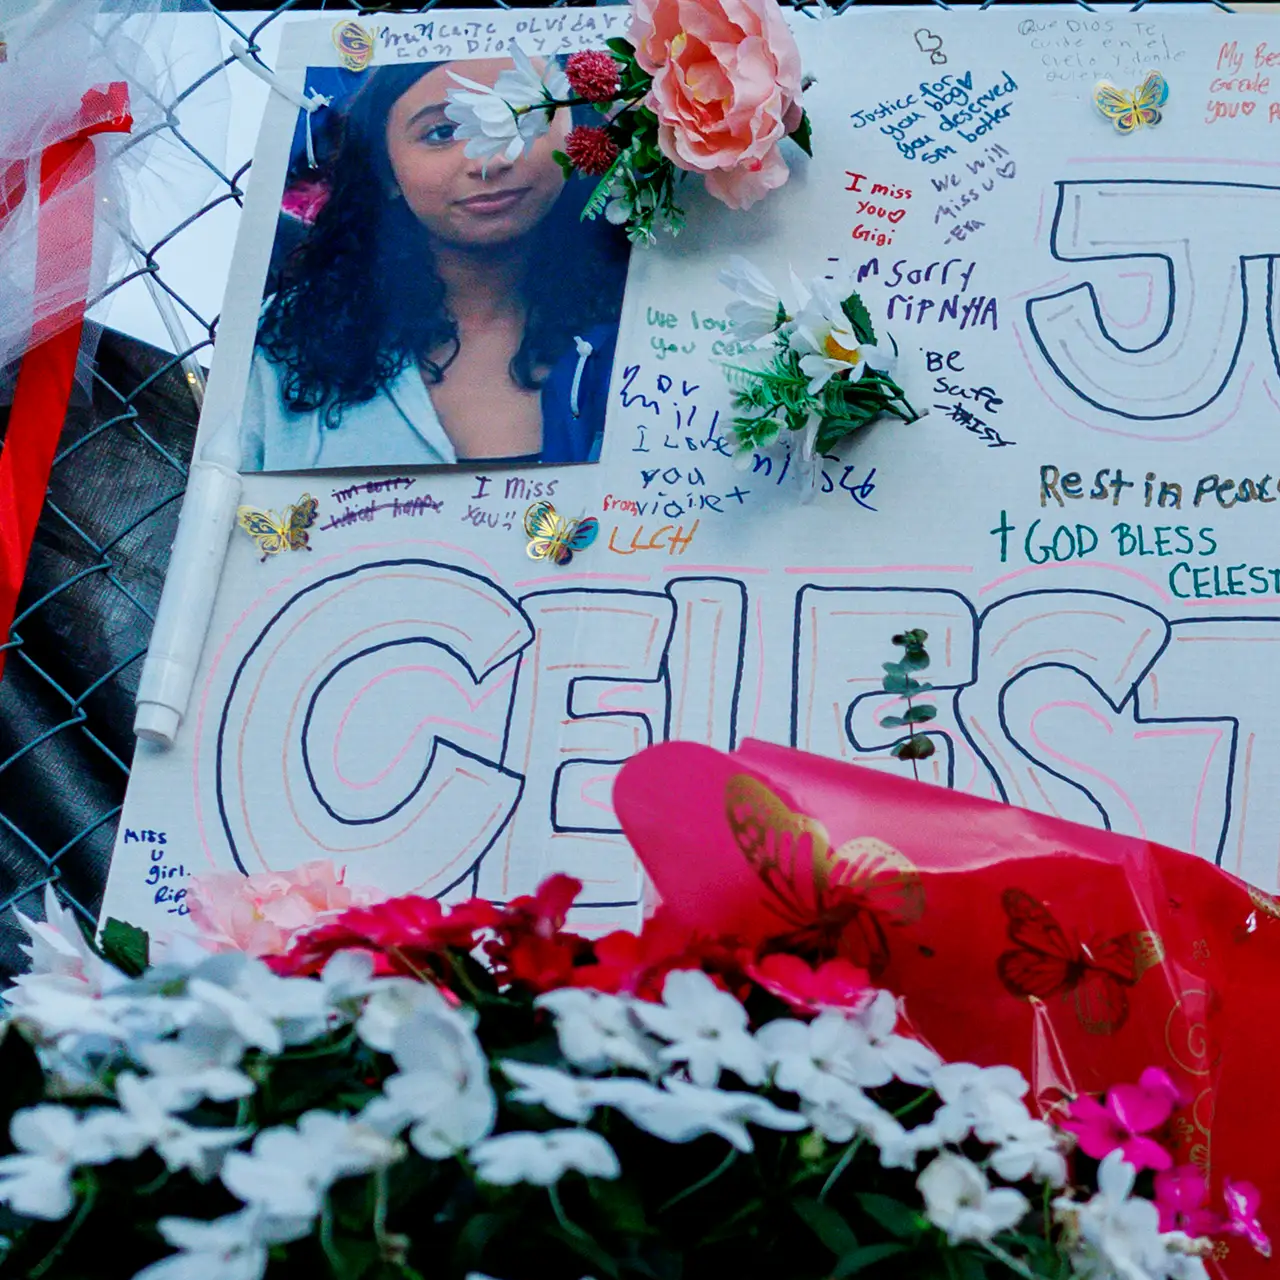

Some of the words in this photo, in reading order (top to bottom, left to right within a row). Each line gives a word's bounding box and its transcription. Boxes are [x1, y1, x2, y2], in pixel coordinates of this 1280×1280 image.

[1216, 41, 1243, 71] My
[850, 94, 918, 129] Justice
[919, 73, 954, 99] for
[897, 135, 935, 160] you
[939, 71, 1018, 132] deserved
[880, 112, 925, 141] you
[931, 174, 961, 192] We
[966, 143, 1010, 175] will
[845, 171, 867, 192] I
[871, 184, 913, 199] miss
[852, 224, 895, 246] Gigi
[632, 425, 650, 452] I
[471, 476, 492, 498] I
[1040, 465, 1134, 508] Rest
[1145, 472, 1182, 509] in
[1025, 520, 1098, 564] GOD
[1116, 525, 1218, 559] BLESS
